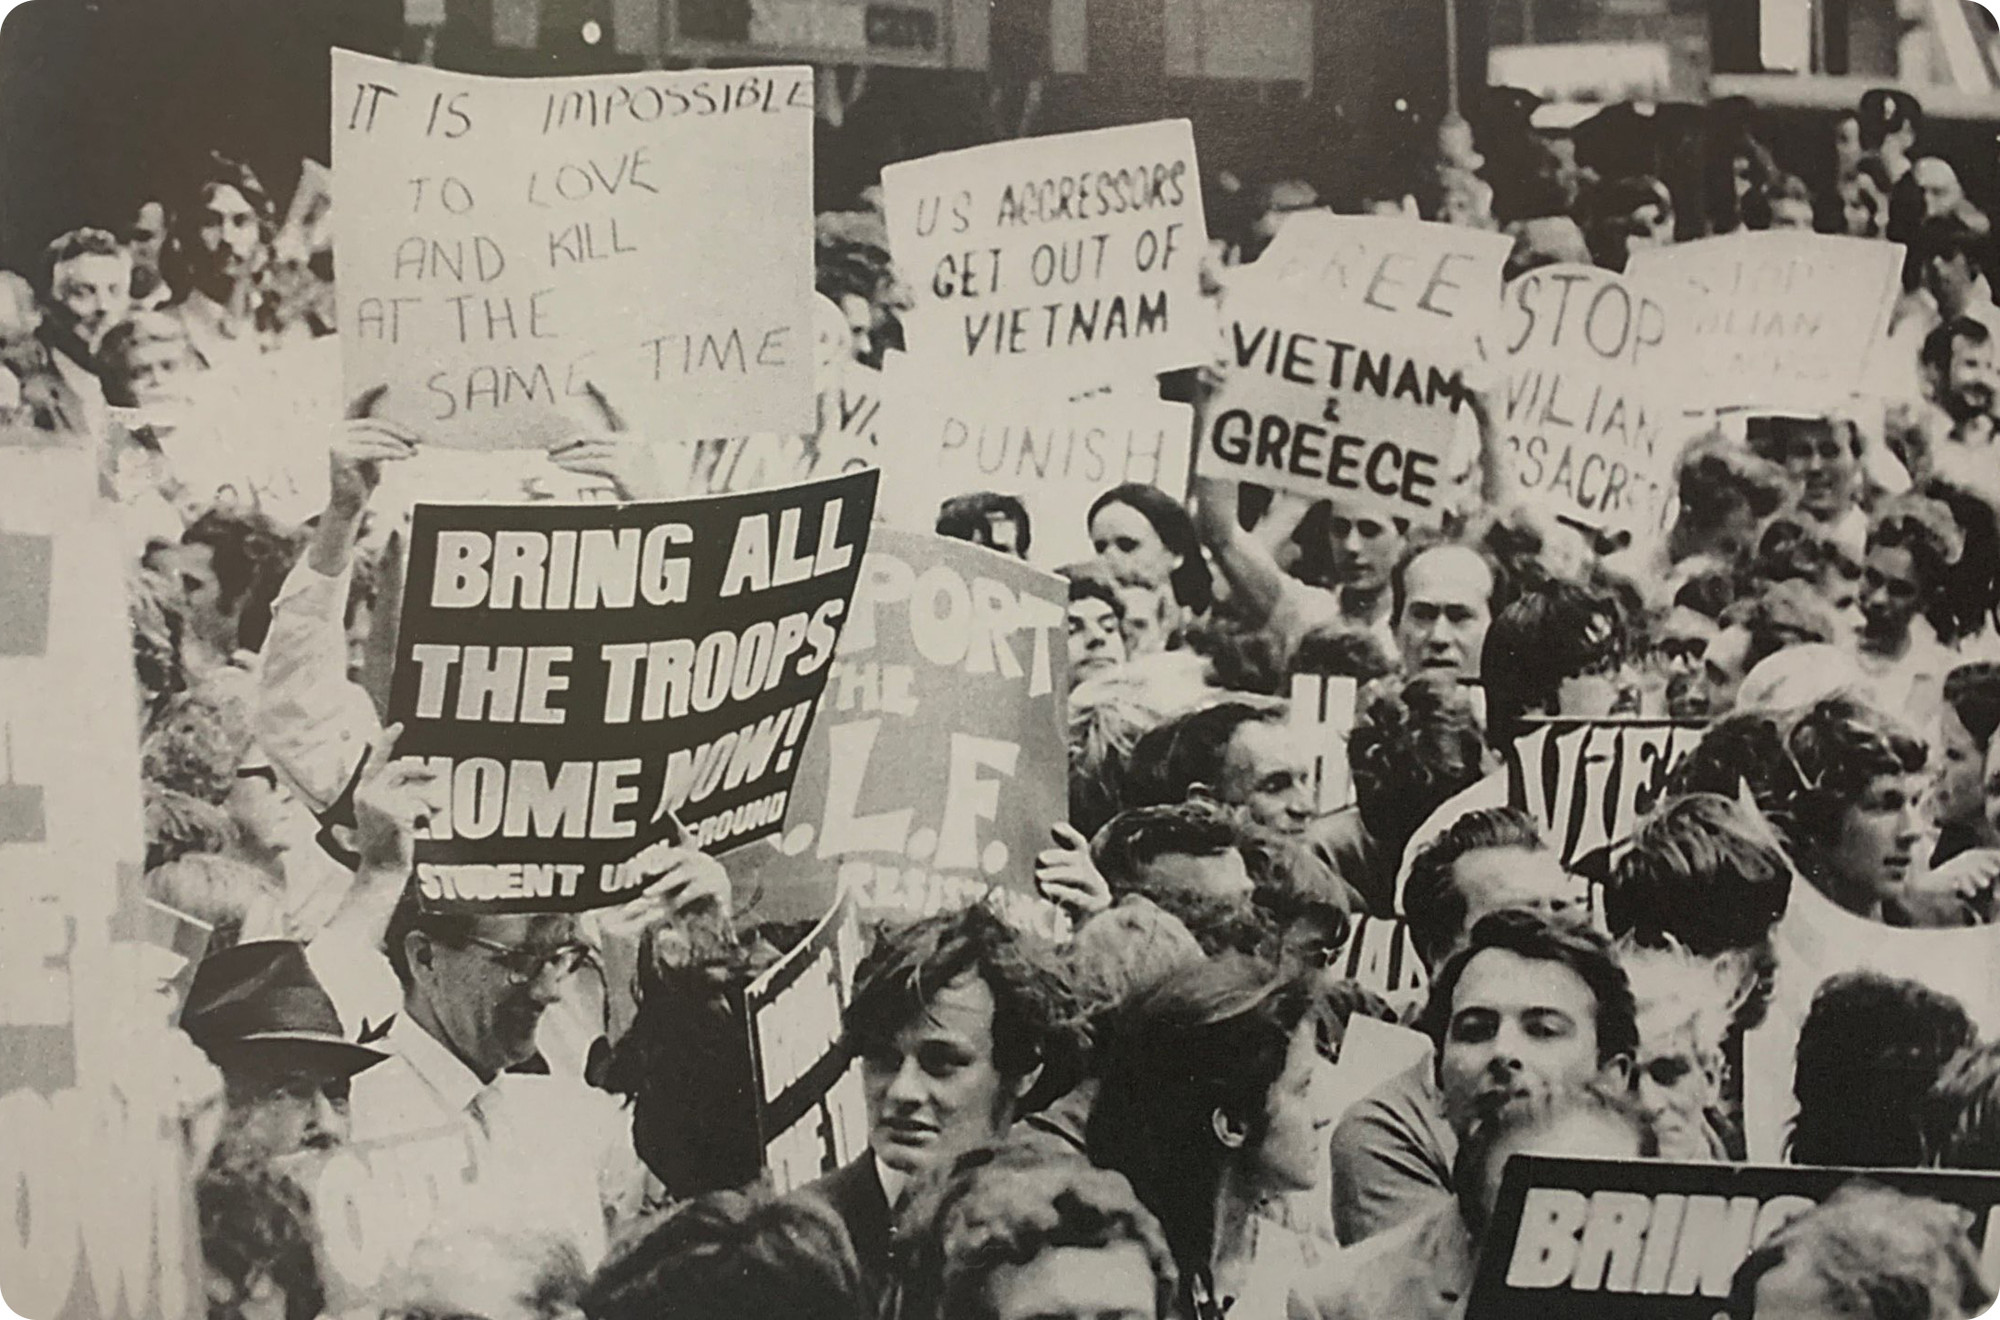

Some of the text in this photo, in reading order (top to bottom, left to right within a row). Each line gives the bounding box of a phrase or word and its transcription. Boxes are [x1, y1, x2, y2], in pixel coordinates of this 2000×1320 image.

[347, 76, 814, 137] IT IS IMPOSSIBLE
[409, 145, 659, 214] TO LOVE
[915, 159, 1187, 238] US AGGRESSORS
[394, 218, 638, 283] AND KILL
[932, 223, 1184, 300] GET OUT OF
[358, 289, 558, 343] AT THE
[964, 290, 1169, 356] VIETNAM
[1505, 274, 1666, 367] STOP
[427, 327, 790, 420] SAME TIME
[1233, 321, 1466, 414] VIETNAM
[938, 417, 1165, 485] PUNISH
[1212, 408, 1440, 508] GREECE
[431, 498, 854, 610] BRING ALL
[412, 598, 844, 724] THE TROOPS
[416, 863, 586, 900] STUDENT
